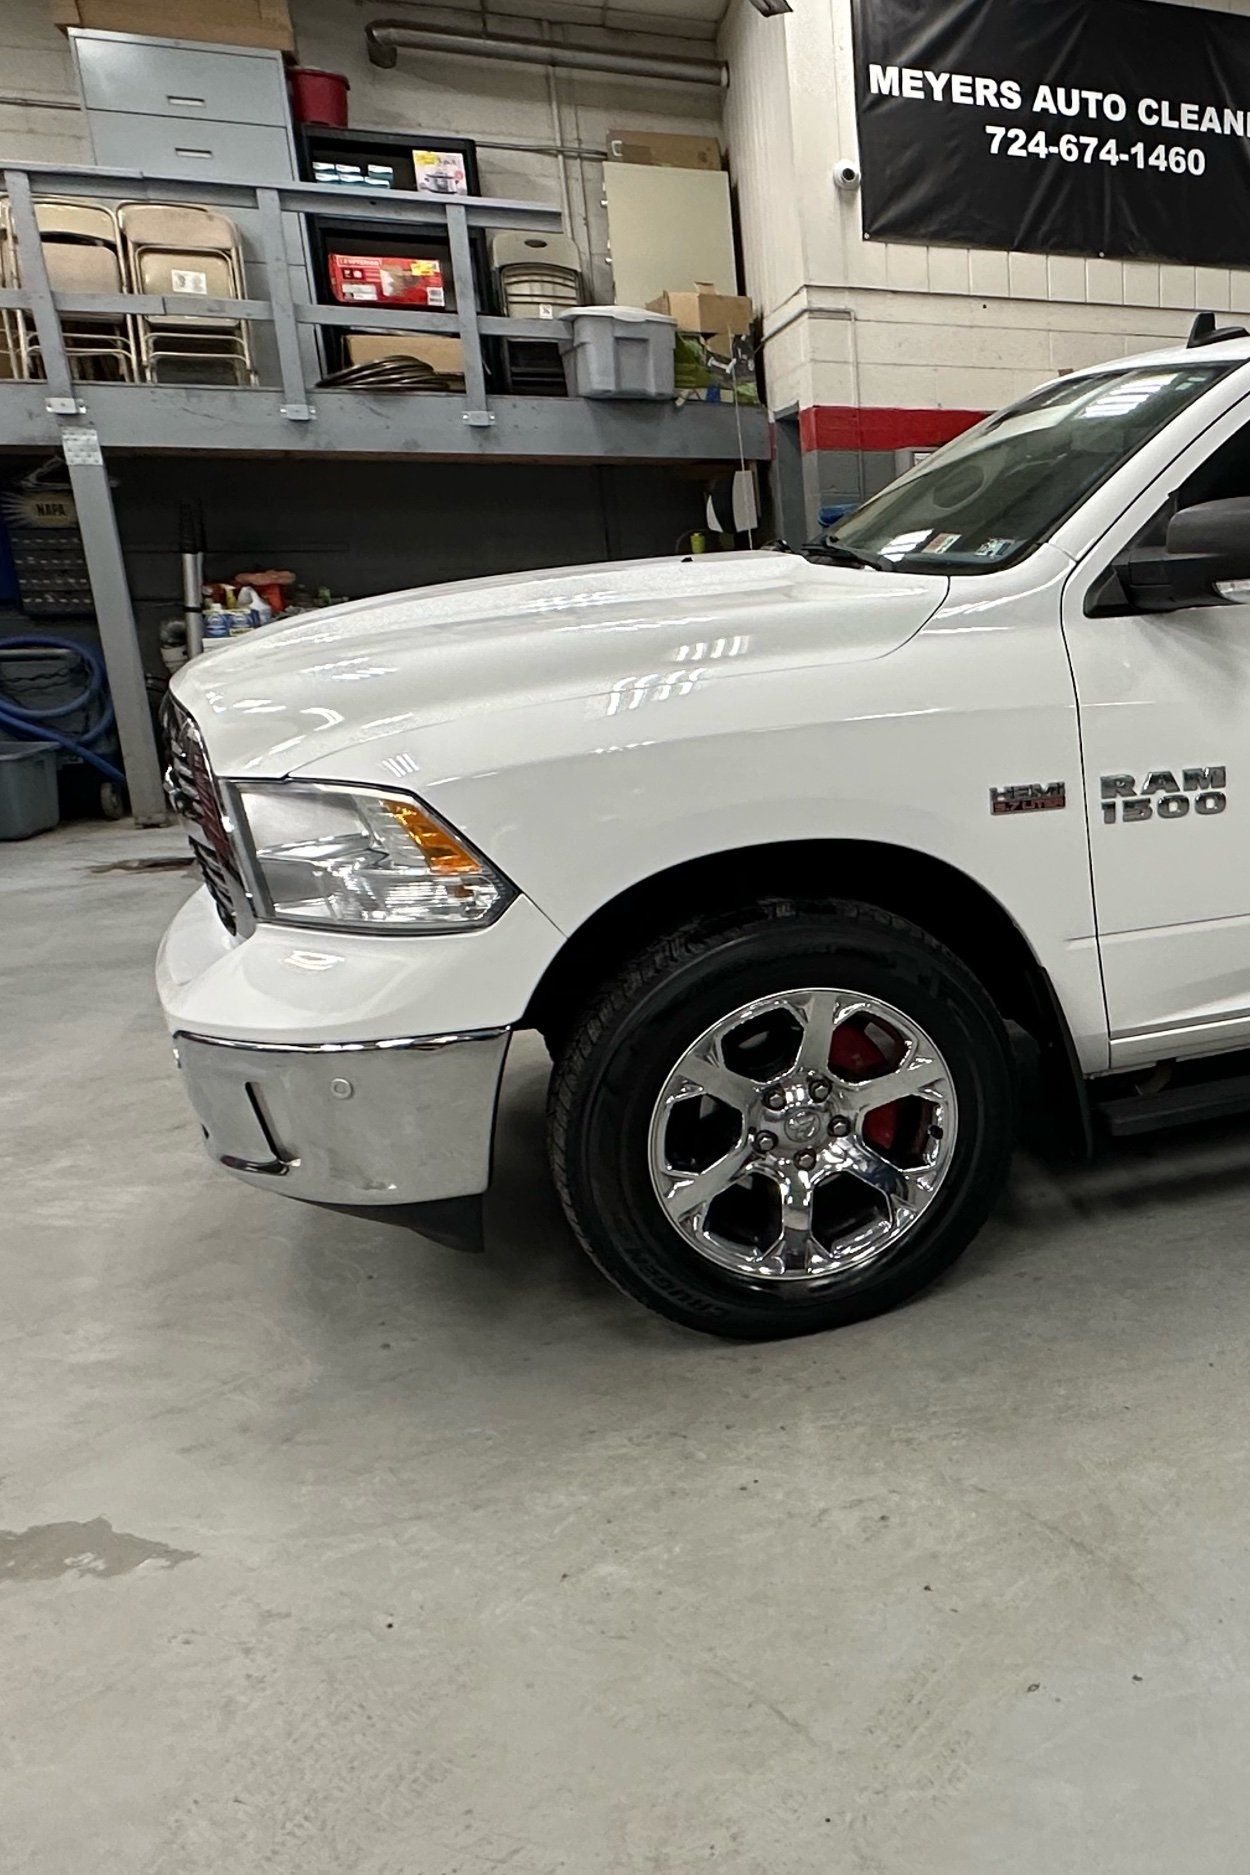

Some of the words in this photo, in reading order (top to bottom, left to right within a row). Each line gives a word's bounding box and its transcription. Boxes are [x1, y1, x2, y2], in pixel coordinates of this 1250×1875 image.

[869, 64, 1021, 110] MEYERS
[1033, 86, 1127, 122] AUTO
[985, 125, 1206, 176] 724-674-1460
[36, 503, 66, 516] NAPA
[989, 782, 1066, 801] HEMI
[1100, 766, 1228, 798] RAM
[1101, 791, 1227, 824] 1500
